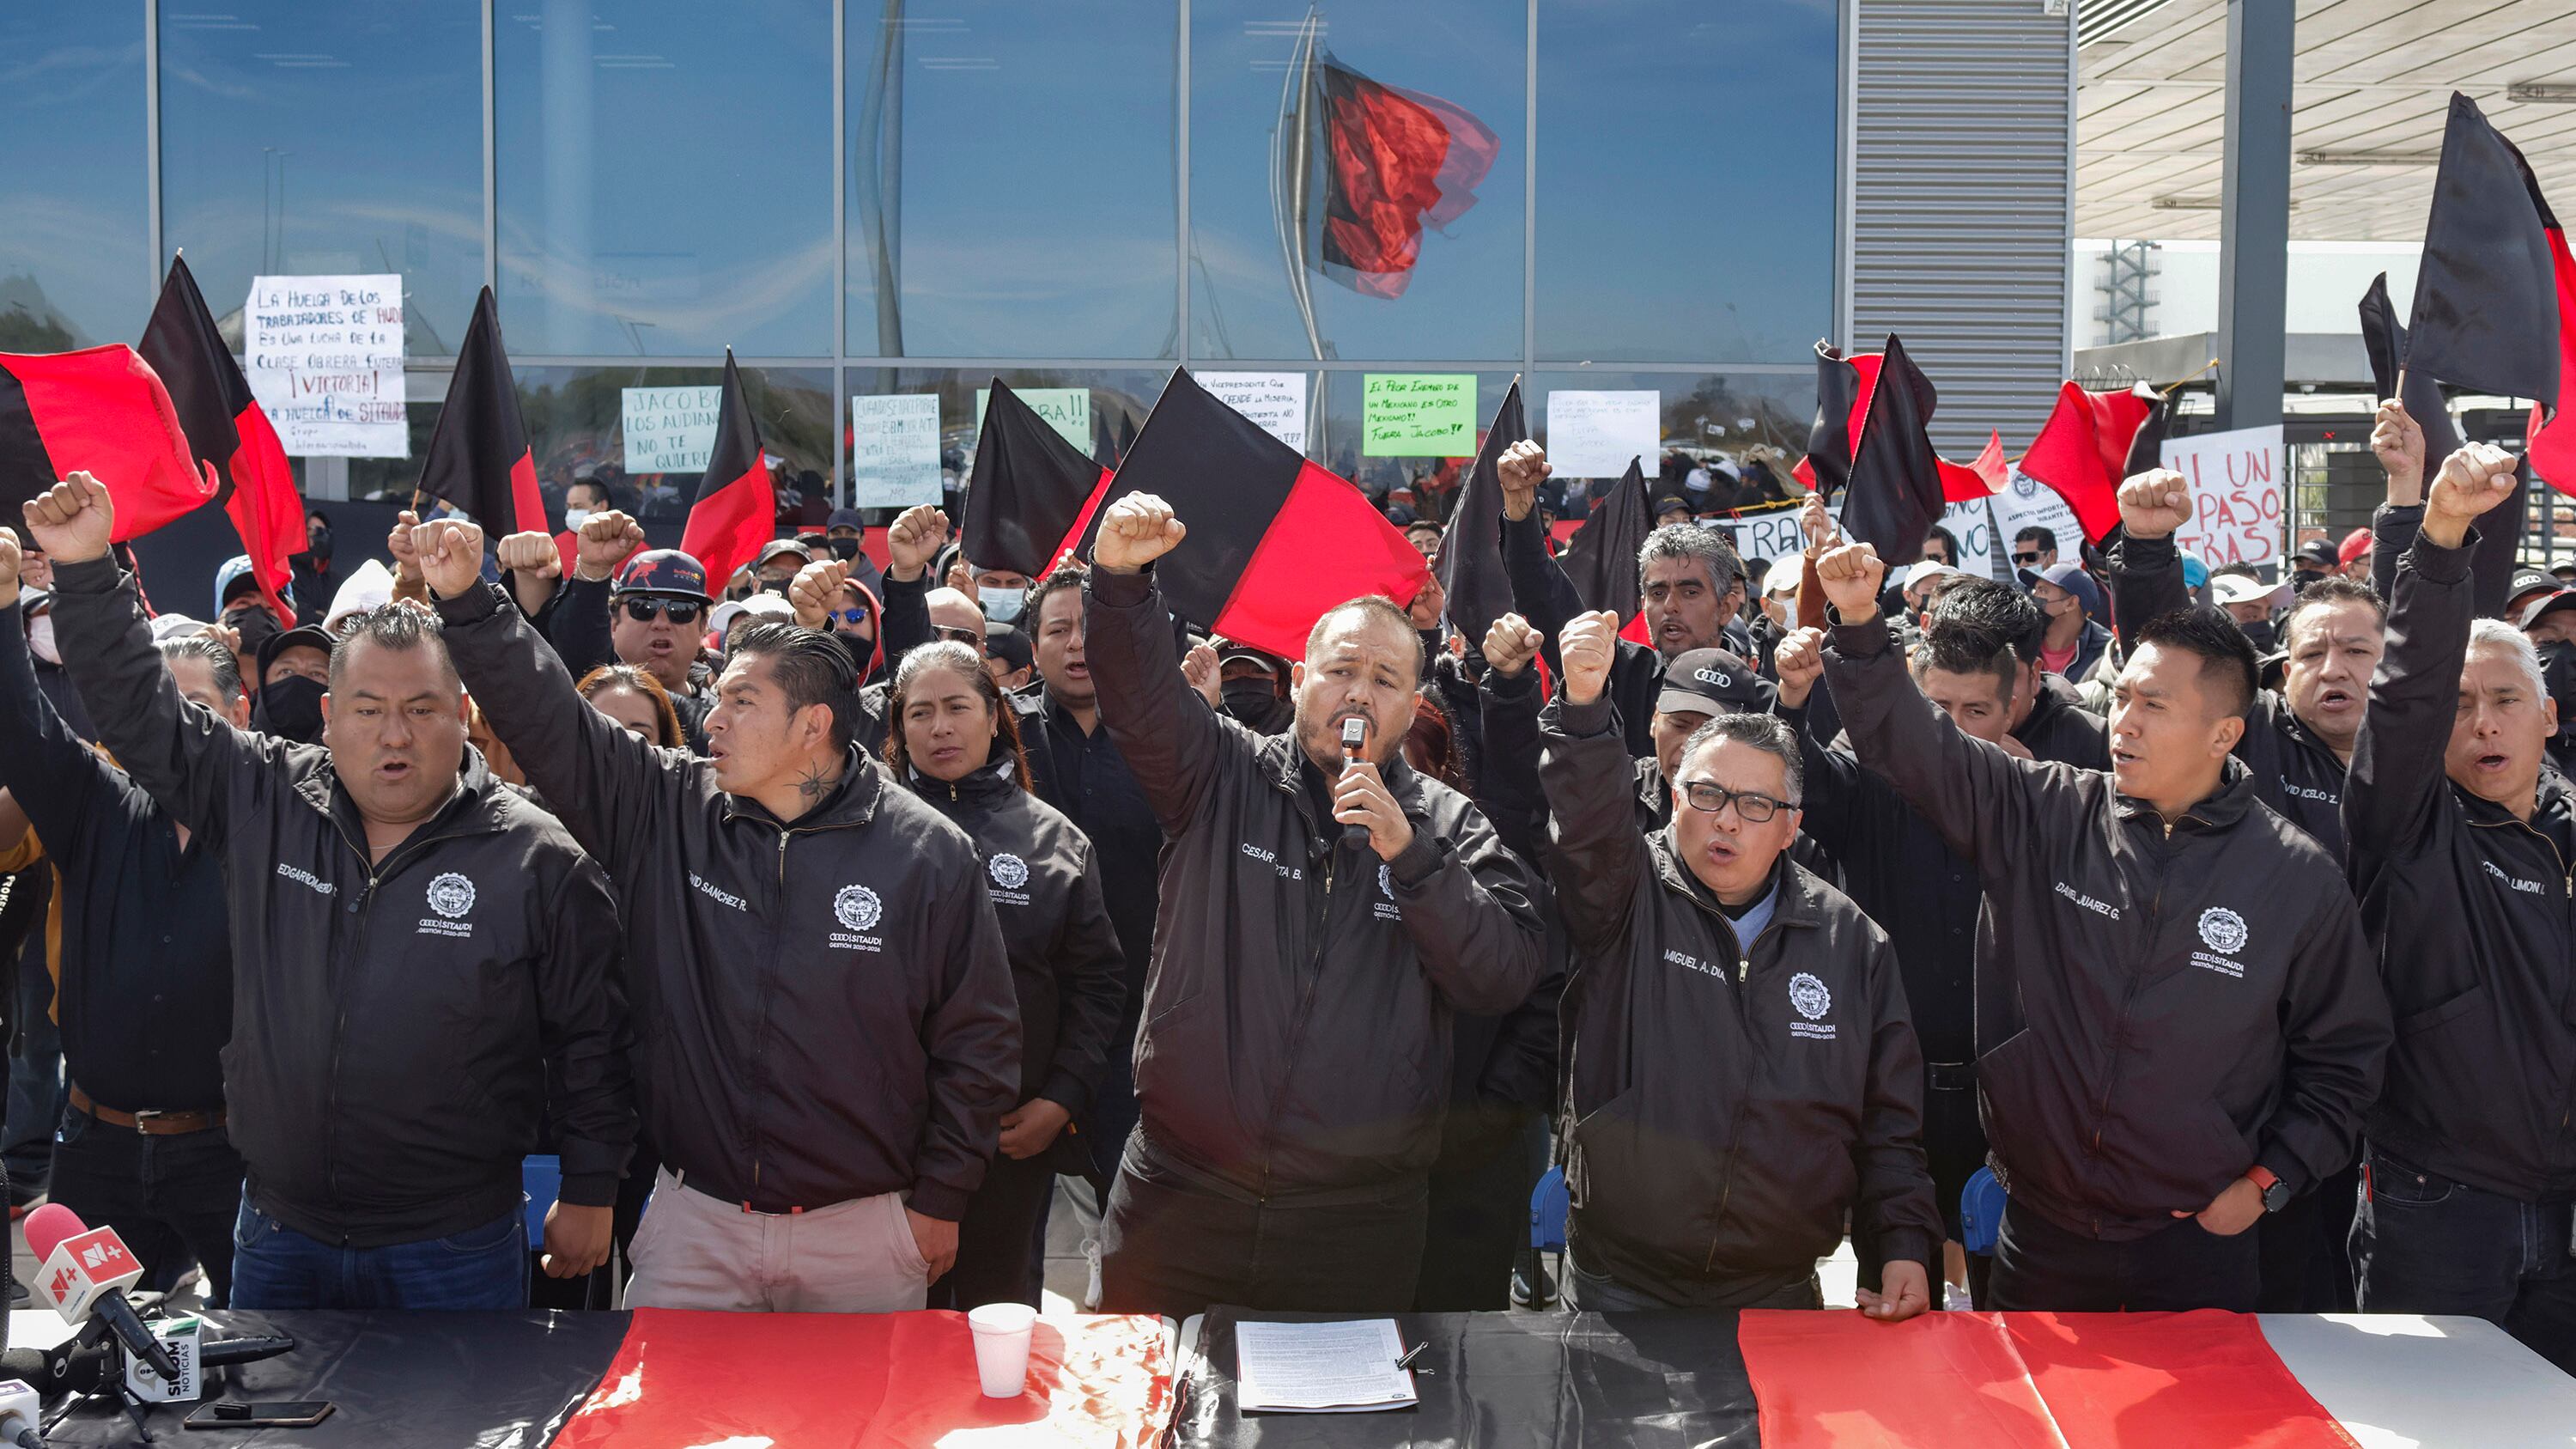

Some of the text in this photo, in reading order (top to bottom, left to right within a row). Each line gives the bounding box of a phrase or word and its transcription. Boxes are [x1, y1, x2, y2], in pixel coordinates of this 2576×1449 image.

[257, 312, 343, 329] TRABAJADORES
[352, 310, 368, 325] DE
[310, 332, 341, 344] LUCHA
[350, 332, 364, 344] DE
[257, 353, 298, 370] CLASE
[307, 353, 357, 369] OBRERA
[1447, 383, 1460, 392] DE
[1436, 399, 1458, 409] OTRO
[626, 411, 720, 433] LOS AUDIAN
[1282, 409, 1295, 418] NO
[637, 434, 686, 456] NO TE
[2227, 447, 2271, 488] UN
[2036, 502, 2067, 515] IMPORTA
[2197, 488, 2281, 533] PASO
[1242, 843, 1275, 863] CESAR
[1291, 868, 1302, 880] B.
[701, 881, 740, 907] SANCHEZ
[738, 898, 747, 912] R.
[1005, 891, 1030, 901] SITAUDI
[2076, 894, 2111, 916] JUAREZ
[2110, 908, 2120, 921] G.
[441, 921, 472, 931] SITAUDI
[852, 935, 883, 946] SITAUDI
[1663, 948, 1728, 985] MIGUEL A. DIA
[2214, 956, 2245, 971] SITAUDI
[1807, 1023, 1836, 1032] SITAUDI
[167, 1341, 181, 1397] SIOM
[180, 1343, 191, 1392] NOTICIAS
